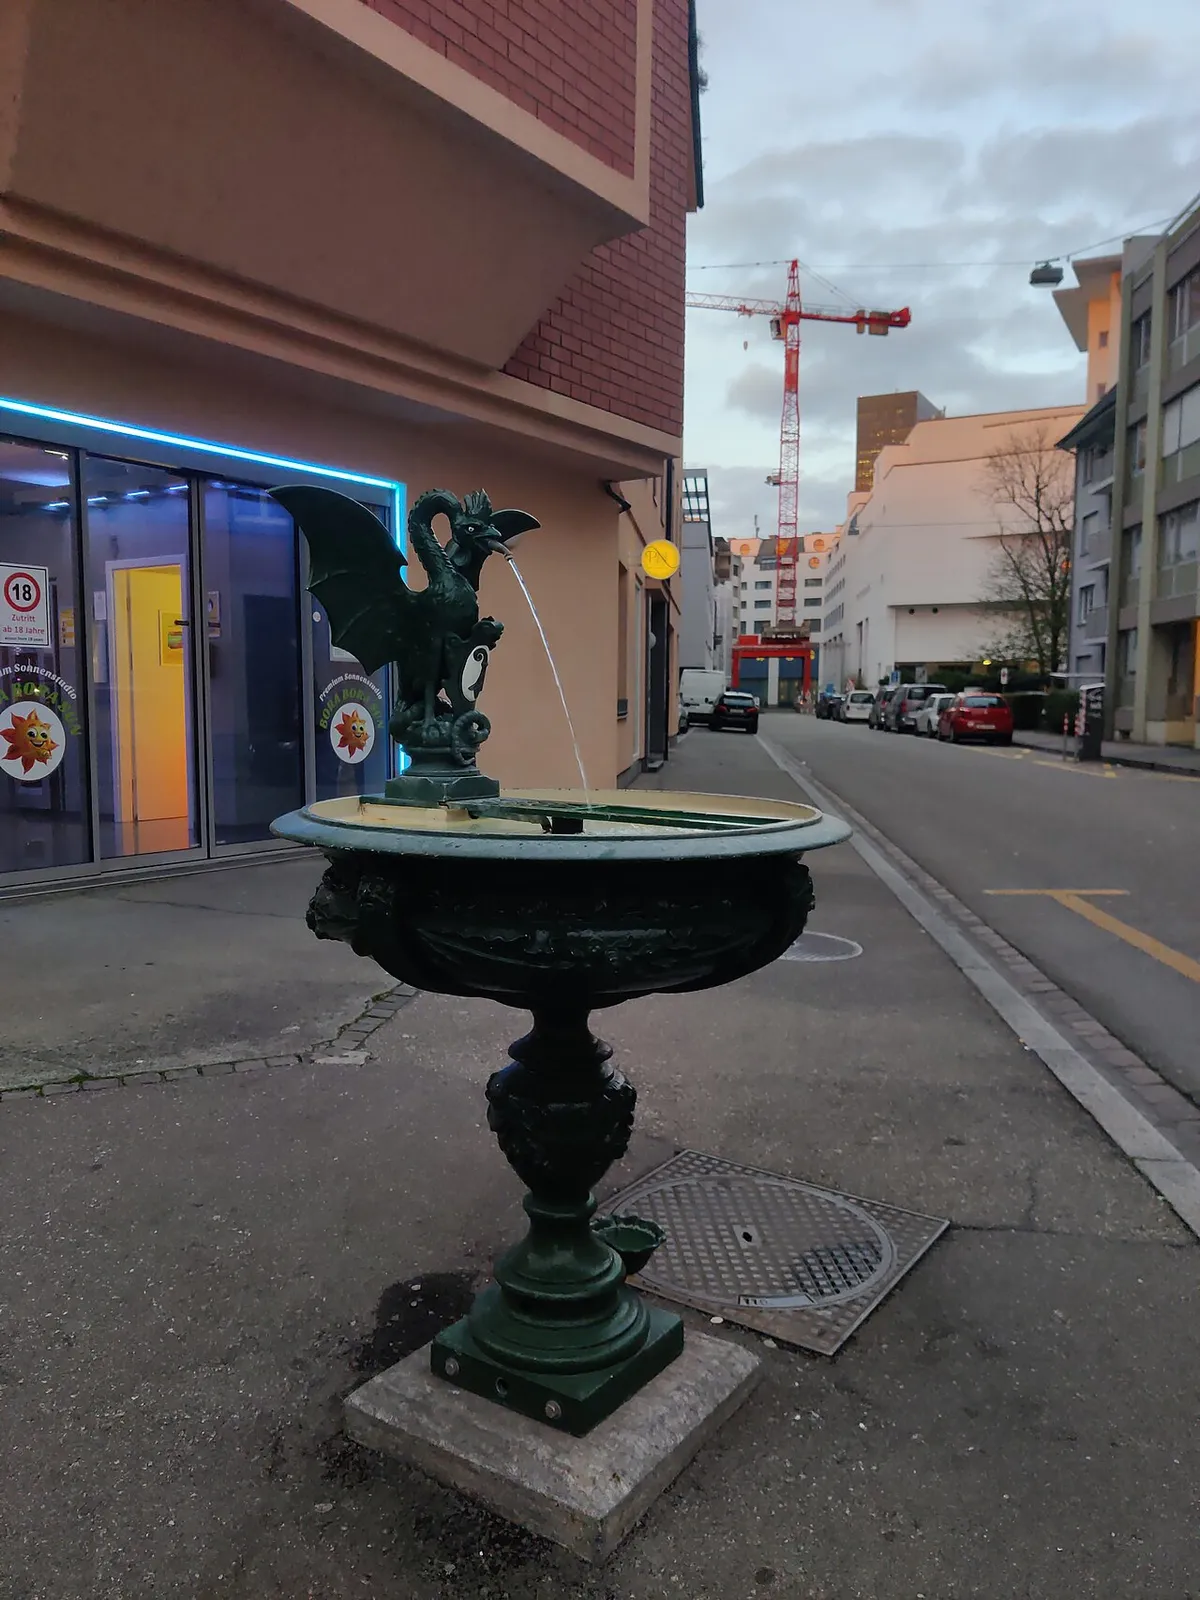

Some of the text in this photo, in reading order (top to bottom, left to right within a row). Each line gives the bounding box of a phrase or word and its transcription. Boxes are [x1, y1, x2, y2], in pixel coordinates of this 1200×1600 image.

[12, 583, 32, 602] 18
[2, 626, 45, 635] ab 18 Jahre
[11, 614, 36, 623] Zutritt
[14, 663, 77, 700] Sonnenstudio
[319, 673, 383, 702] Premium Sonnenstudio
[319, 692, 341, 730] BORA
